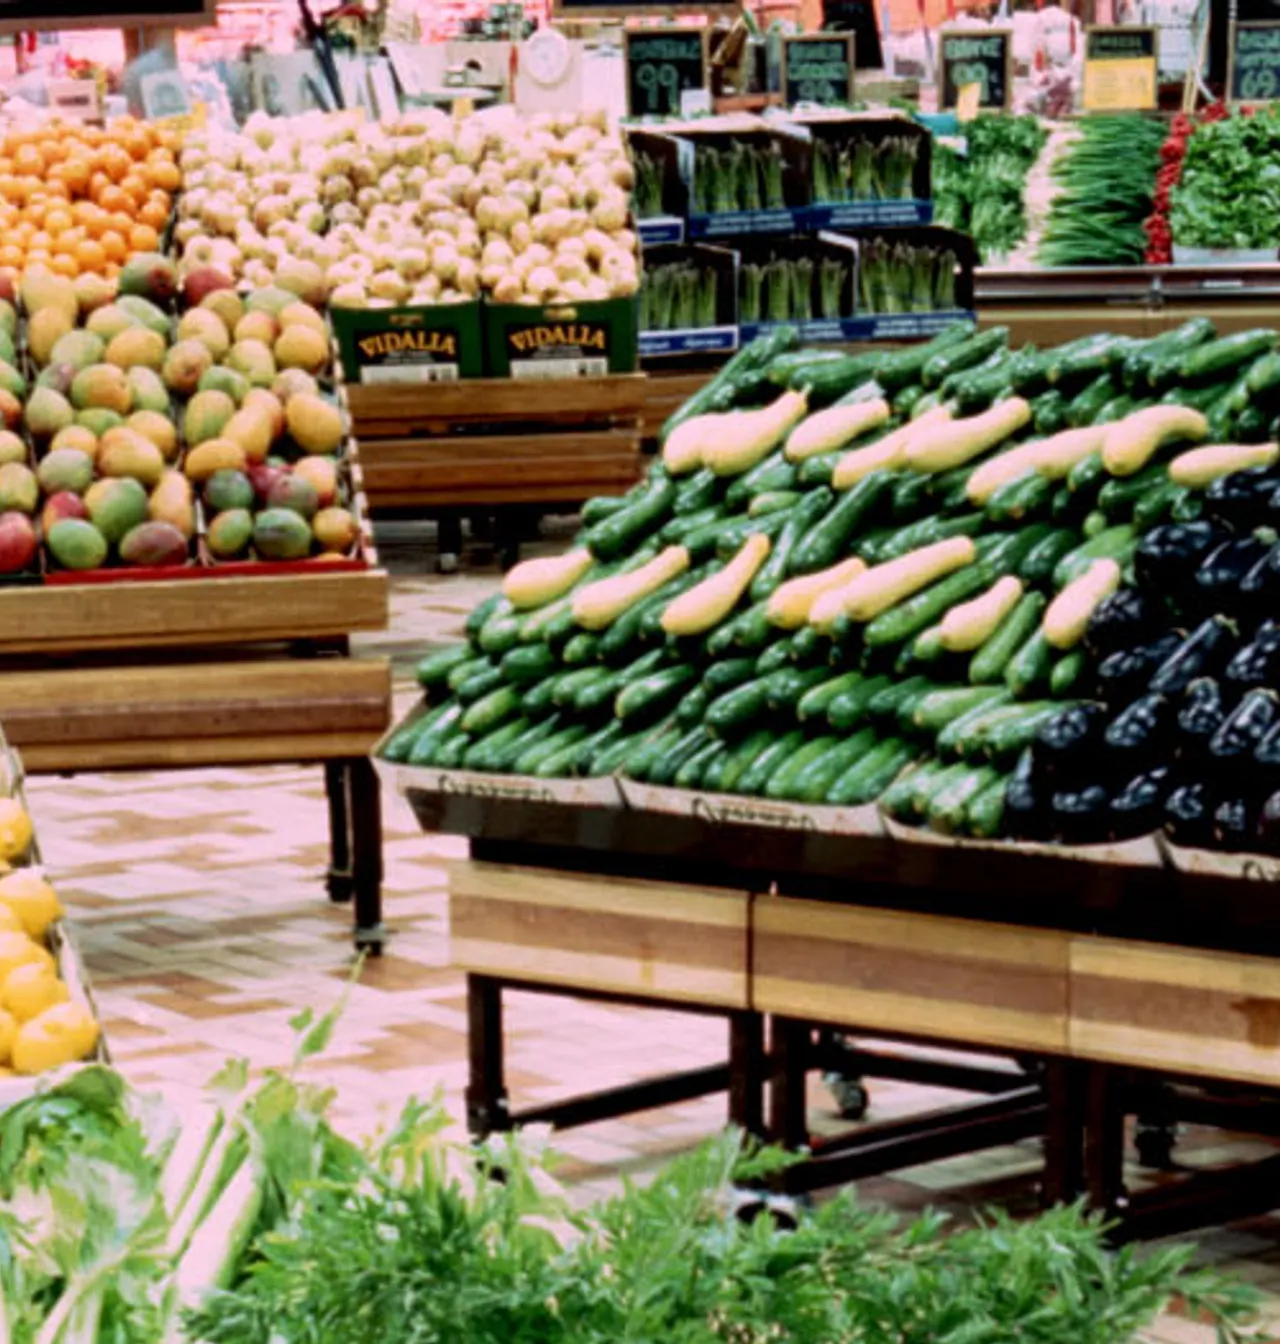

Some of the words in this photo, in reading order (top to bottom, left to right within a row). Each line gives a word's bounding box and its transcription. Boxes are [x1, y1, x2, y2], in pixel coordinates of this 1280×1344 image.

[635, 62, 679, 109] 99
[359, 328, 456, 358] VIDALIA
[509, 323, 606, 353] VIDALIA
